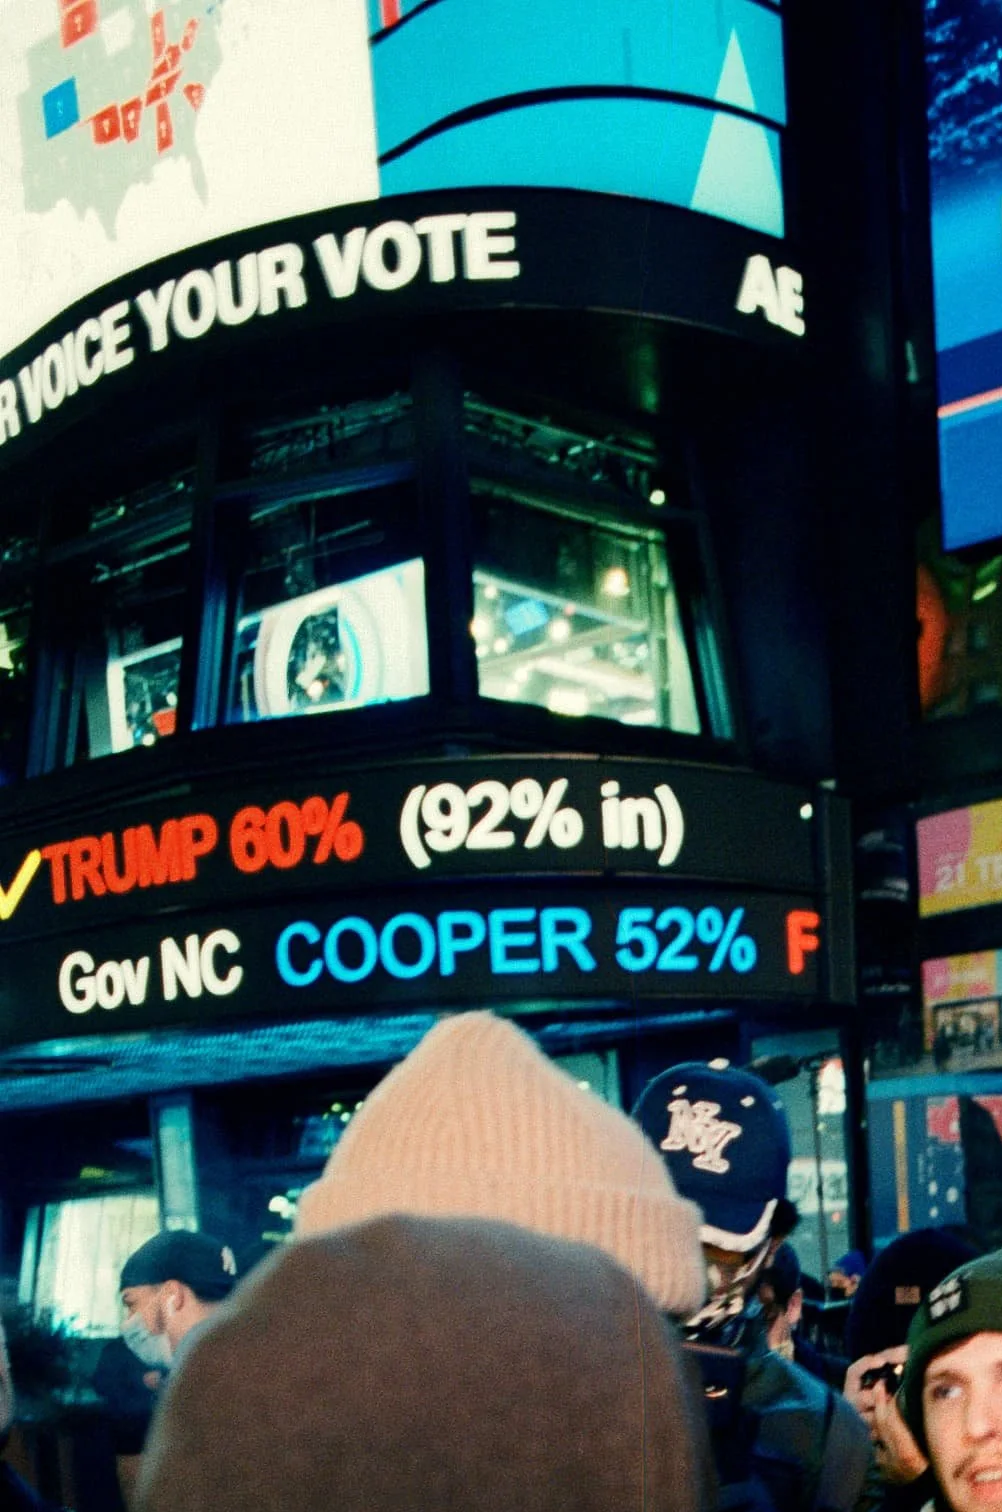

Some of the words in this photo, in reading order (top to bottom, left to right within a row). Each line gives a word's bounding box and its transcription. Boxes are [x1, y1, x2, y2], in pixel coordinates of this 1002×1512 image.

[17, 299, 135, 425] VOICE
[136, 242, 308, 353] YOUR
[313, 211, 520, 299] VOTE
[42, 811, 219, 906] TRUMP
[228, 792, 365, 874] 60%
[400, 777, 584, 869] (92%
[600, 780, 685, 868] in)
[57, 950, 151, 1014] Gov
[159, 928, 244, 1000] NC
[274, 907, 596, 988] COOPER
[615, 905, 757, 975] 52%
[785, 909, 820, 975] F
